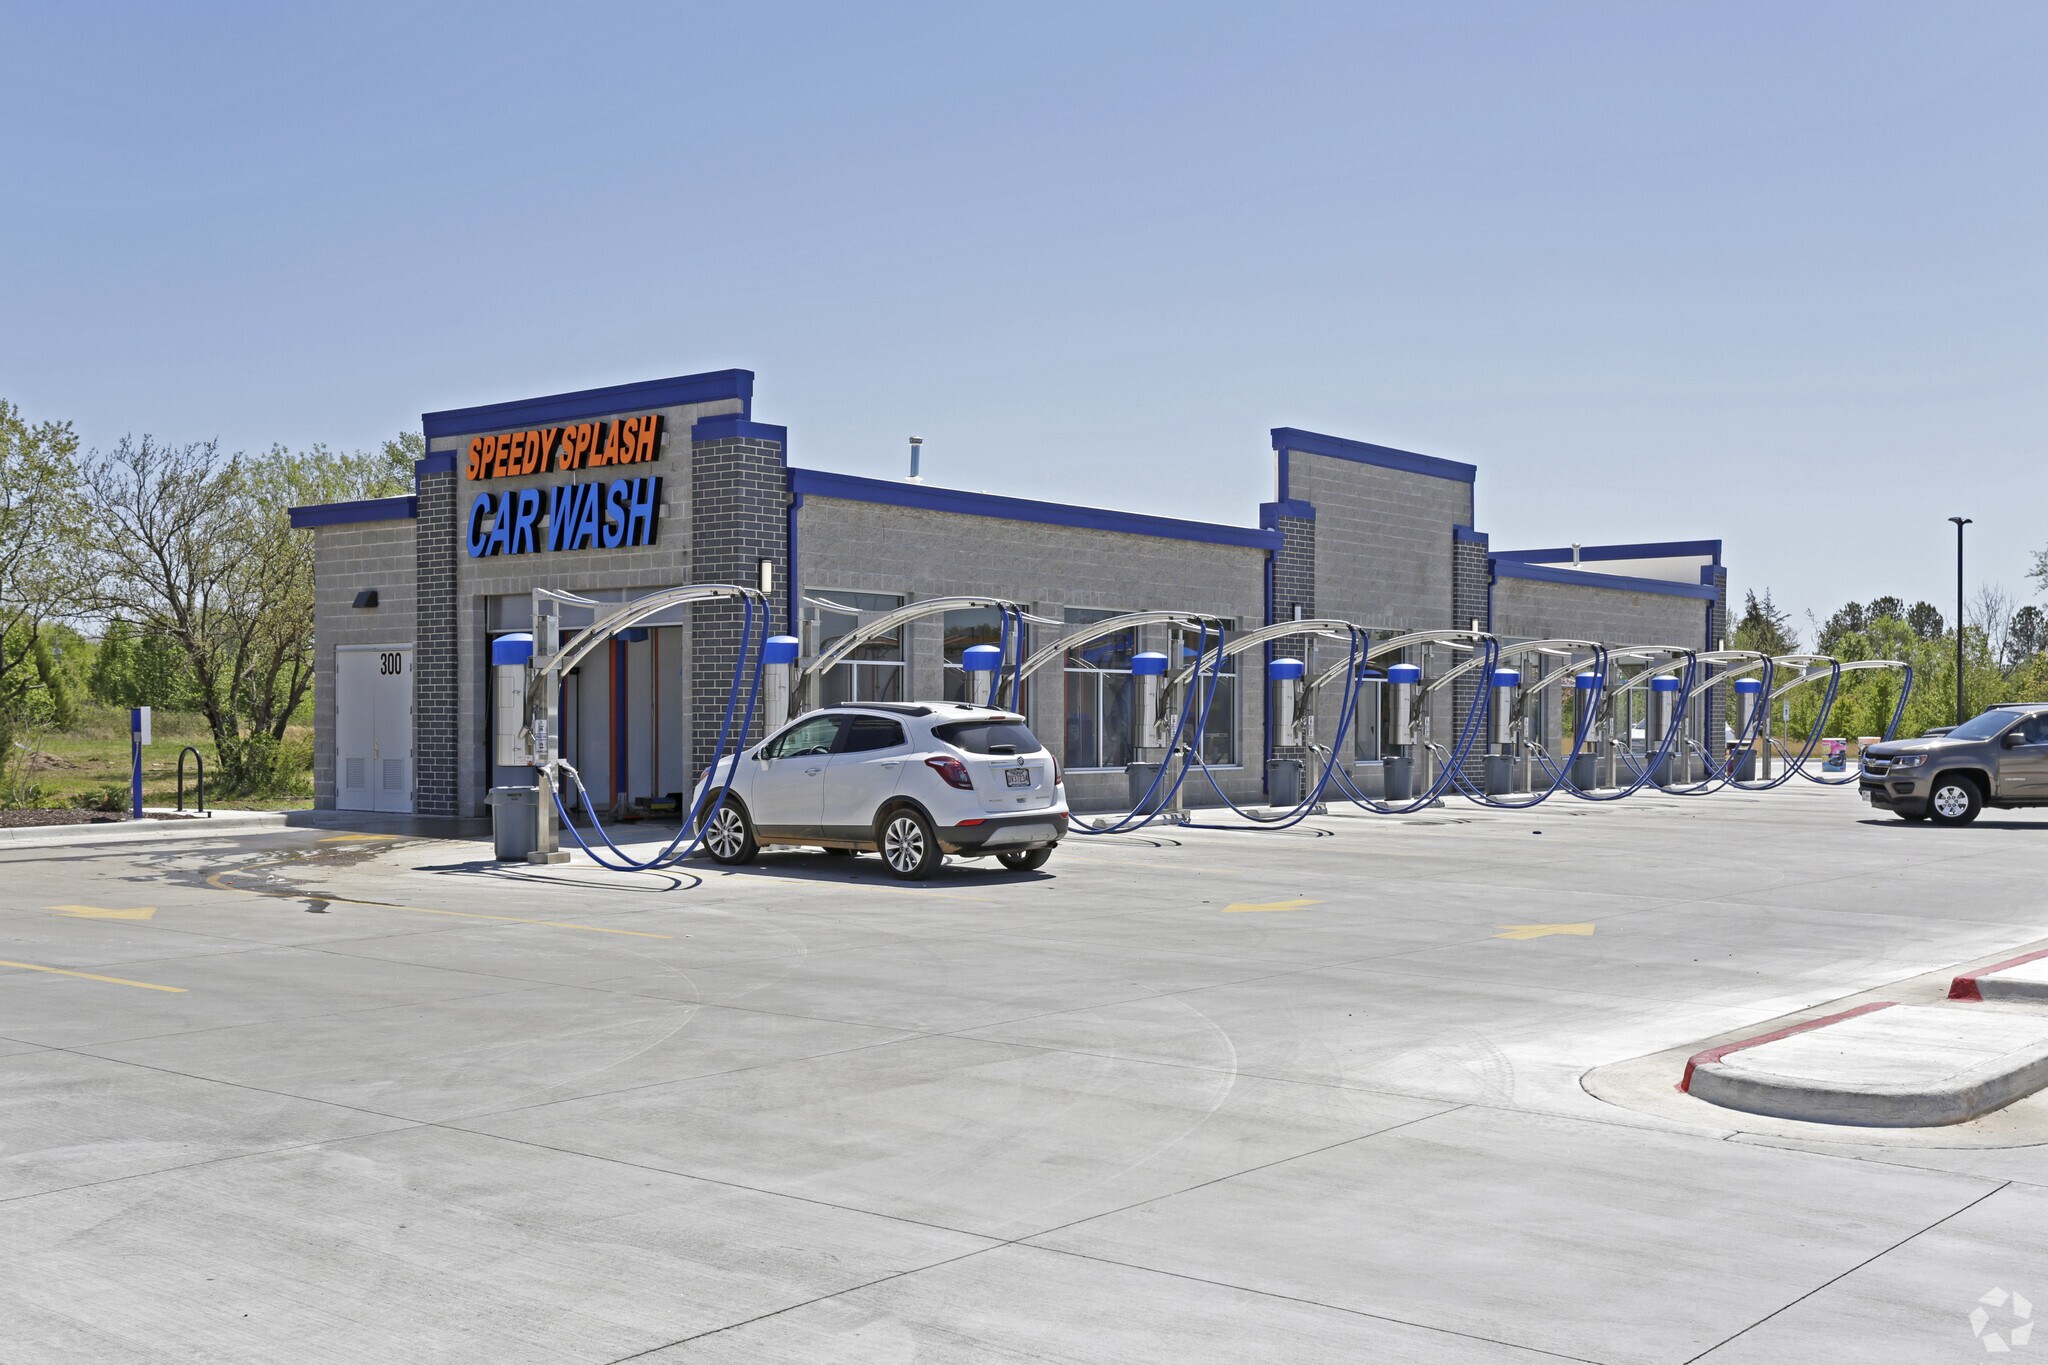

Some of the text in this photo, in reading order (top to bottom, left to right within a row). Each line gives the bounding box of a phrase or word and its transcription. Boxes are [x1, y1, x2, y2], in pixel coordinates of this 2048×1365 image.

[466, 414, 659, 481] SPEEDY SPLASH
[466, 476, 658, 558] CAR WASH
[380, 652, 402, 675] 300
